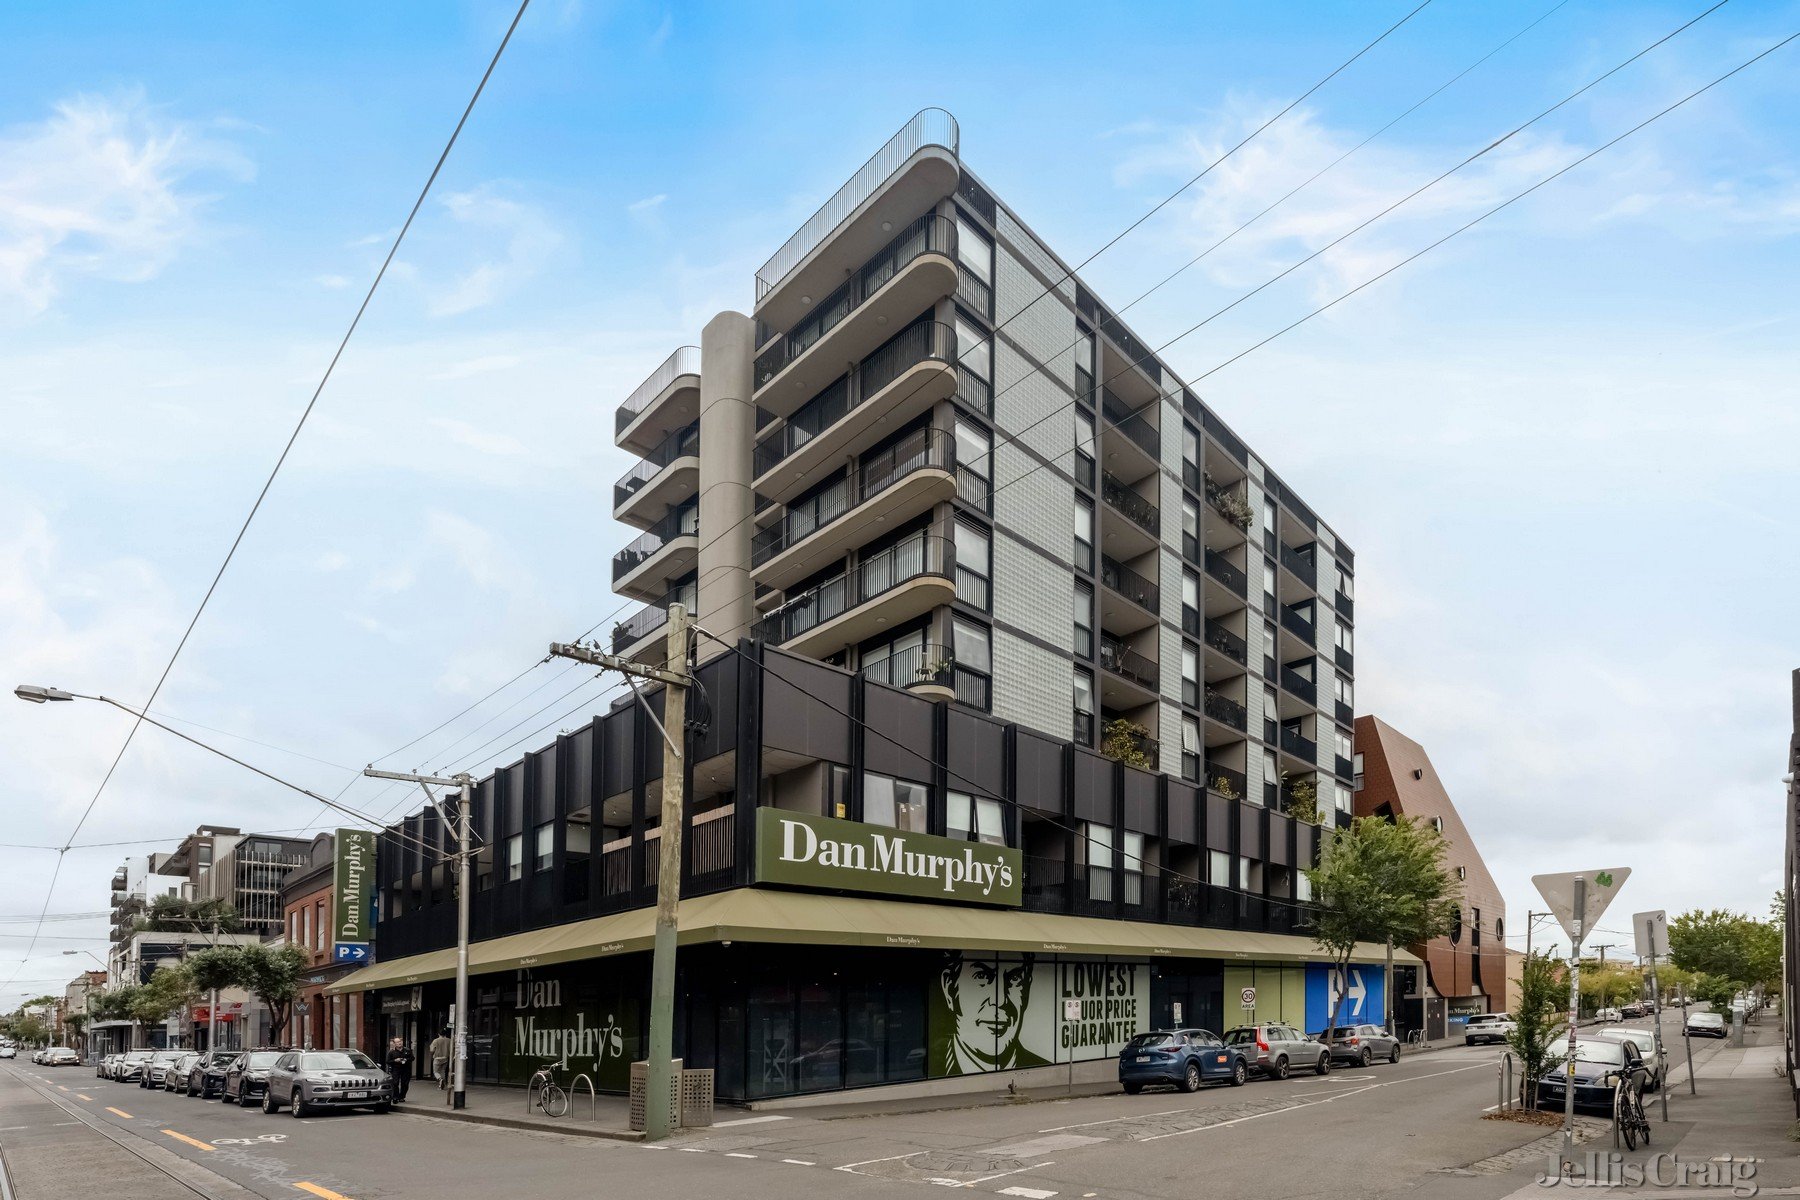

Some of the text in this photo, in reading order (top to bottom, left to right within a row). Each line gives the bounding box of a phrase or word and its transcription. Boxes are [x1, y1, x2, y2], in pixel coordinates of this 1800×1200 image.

[779, 819, 1013, 896] Dan Murphy's
[342, 834, 366, 937] Dan Murphy's
[339, 947, 350, 958] P
[515, 968, 562, 1009] Dan
[1062, 963, 1137, 998] LOWEST
[1062, 999, 1137, 1022] LUOR PRICE
[514, 1012, 623, 1073] Murphy's
[1062, 1021, 1137, 1049] GUARANTEE
